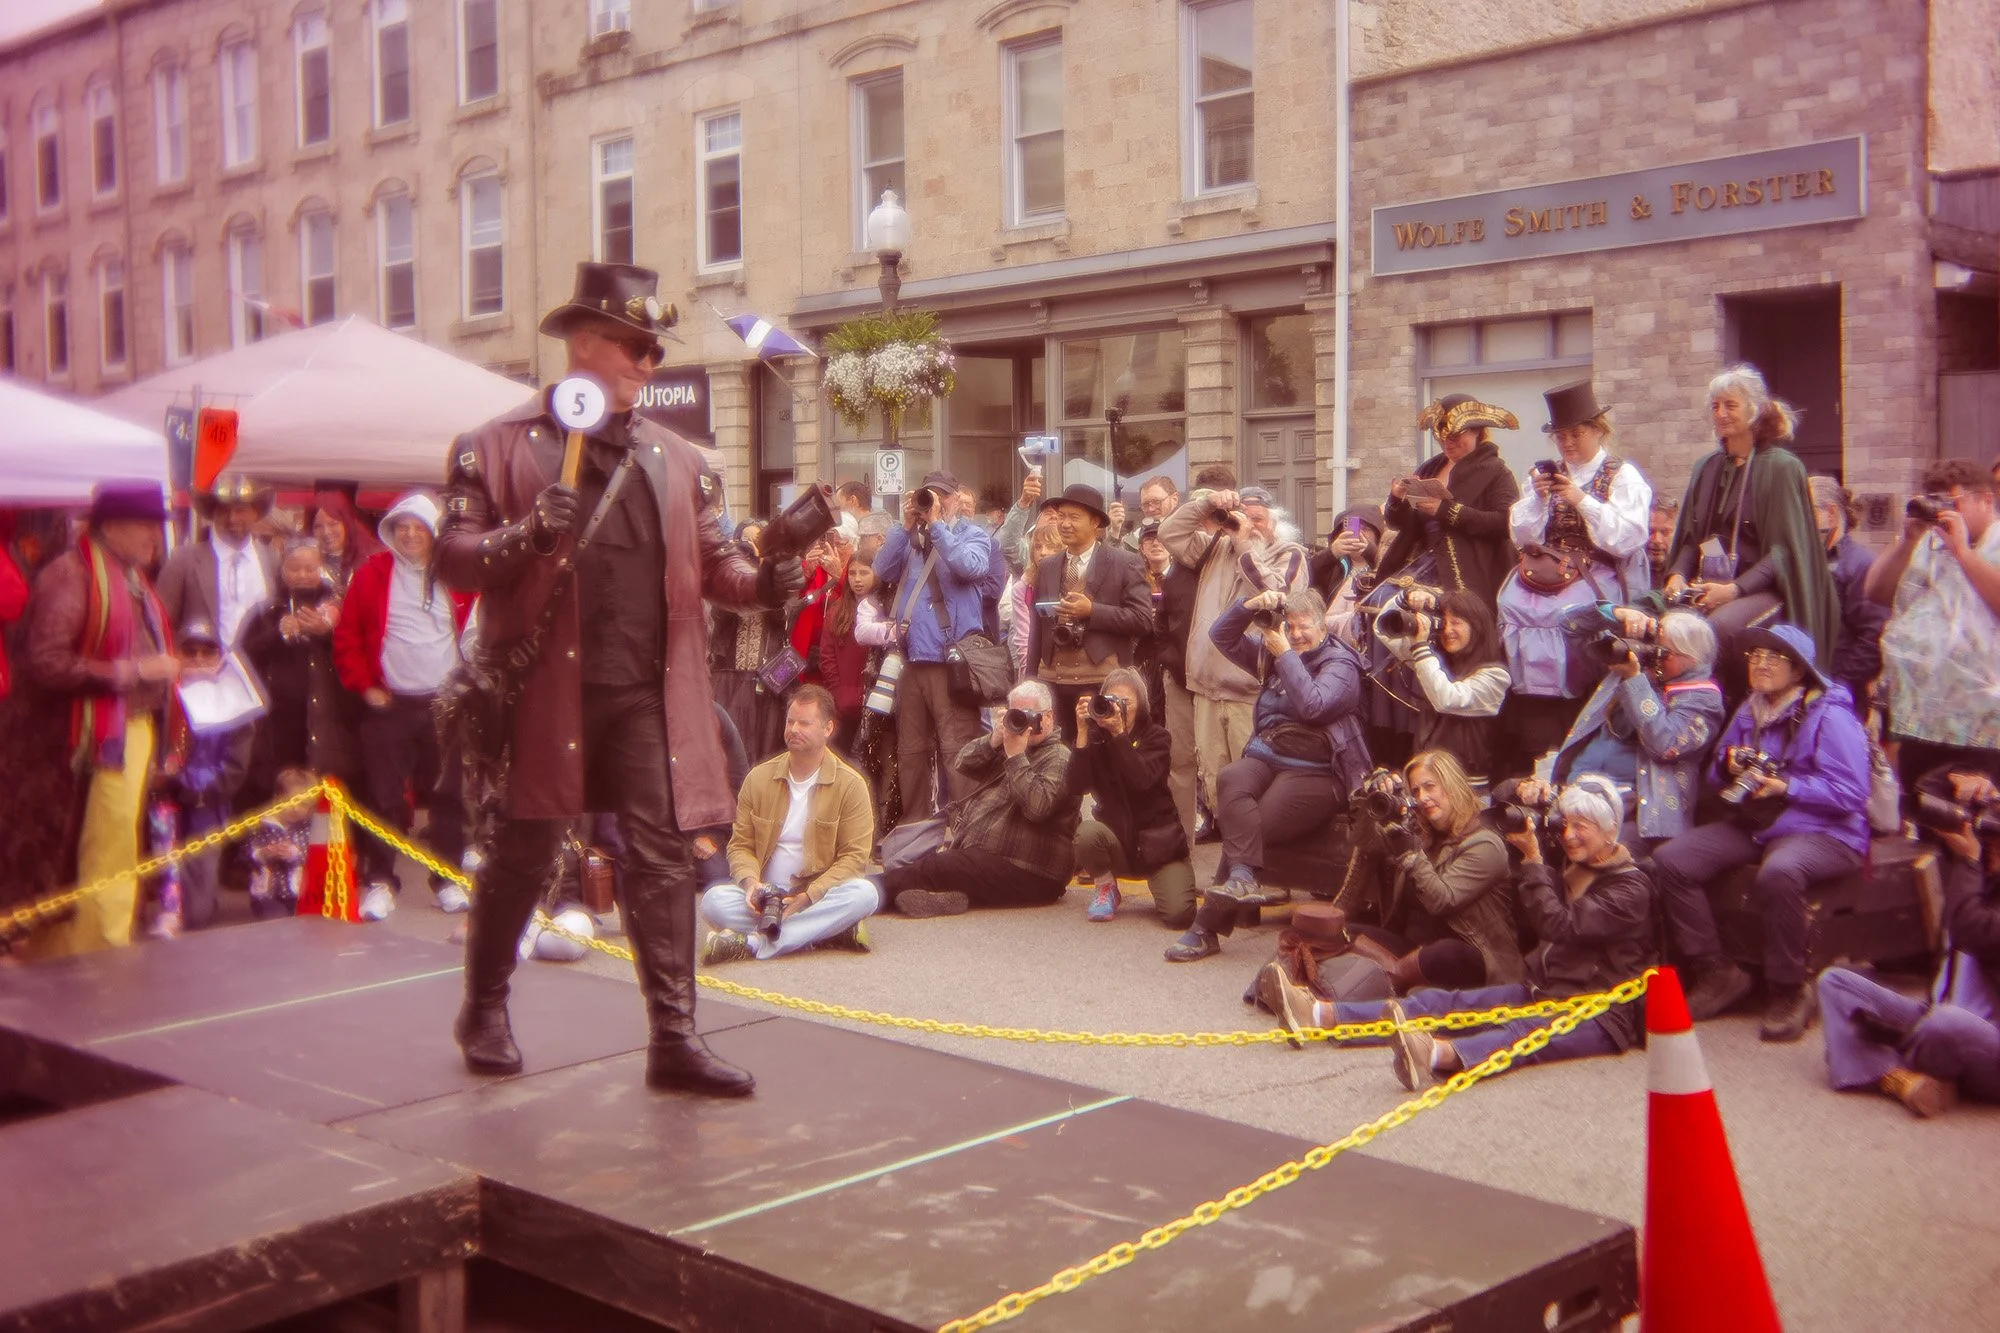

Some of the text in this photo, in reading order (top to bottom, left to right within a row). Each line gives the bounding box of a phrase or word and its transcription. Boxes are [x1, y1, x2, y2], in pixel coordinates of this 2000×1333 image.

[1392, 168, 1836, 251] WOLFE SMITH & FORSTER
[572, 393, 585, 415] 5
[886, 457, 895, 468] P
